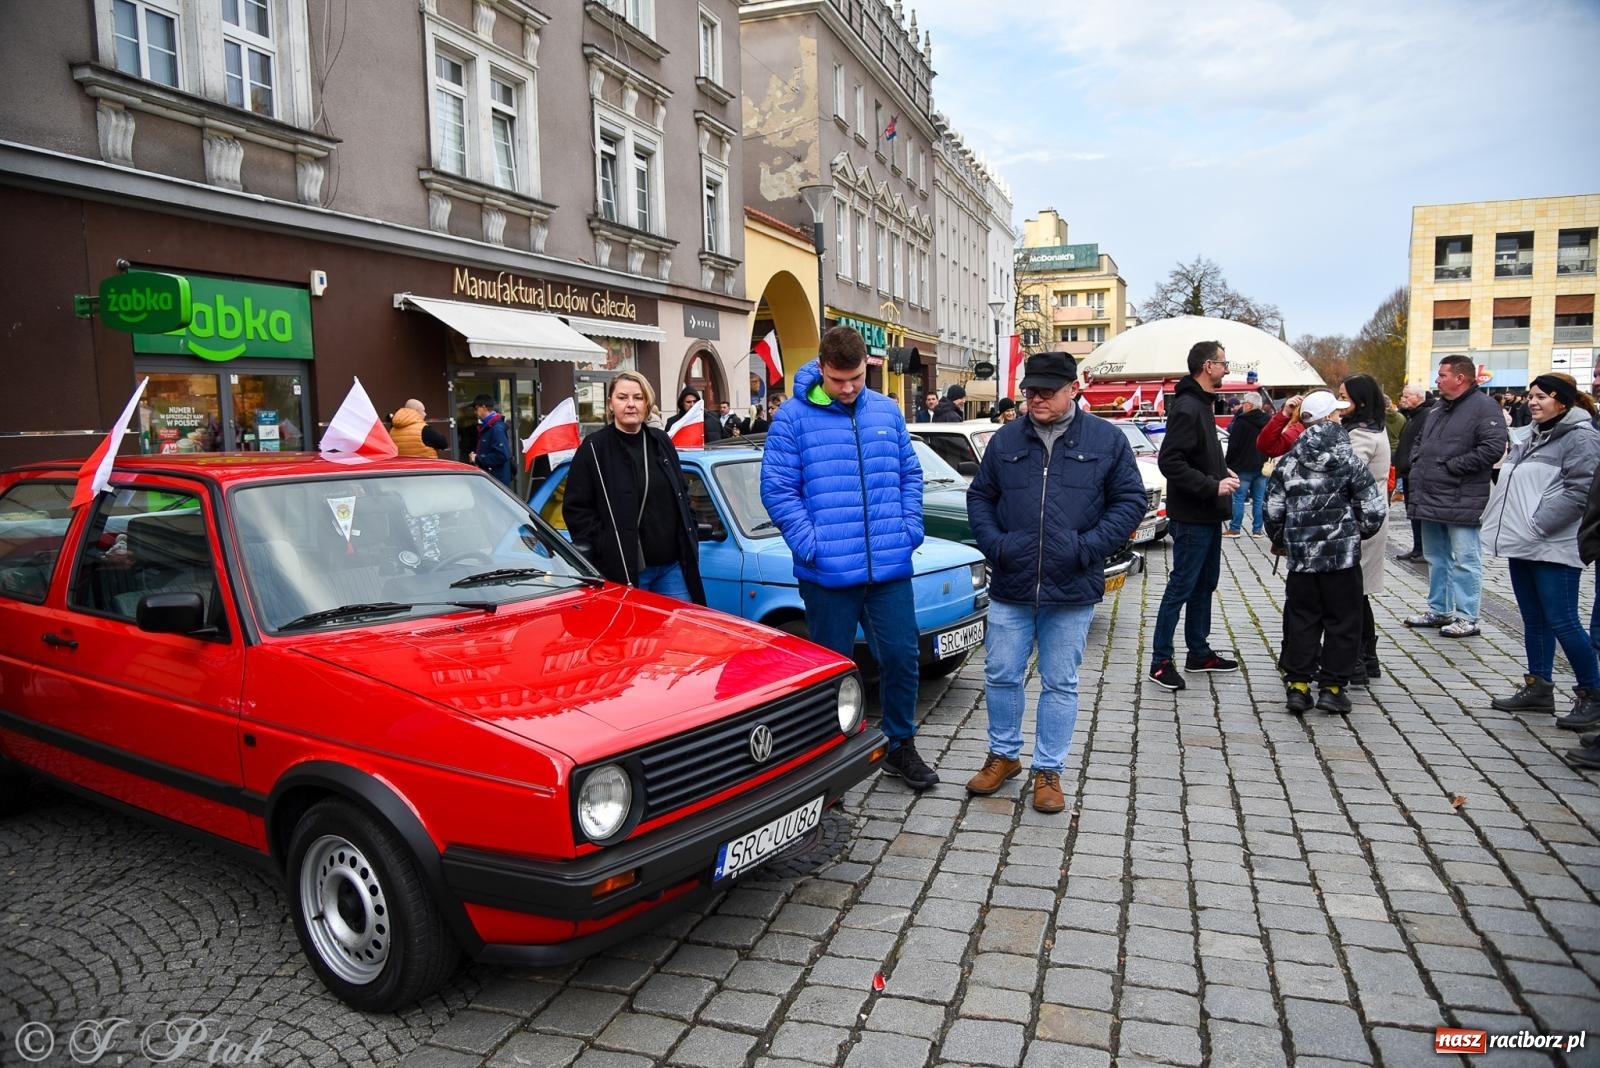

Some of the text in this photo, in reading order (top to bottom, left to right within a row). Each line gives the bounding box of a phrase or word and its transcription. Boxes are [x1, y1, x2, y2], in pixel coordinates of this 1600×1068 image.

[1030, 253, 1075, 263] McDonald's
[107, 288, 173, 312] żabka
[454, 267, 637, 322] Manufaktura Lodów Gałeczka
[163, 294, 293, 342] abka
[169, 406, 192, 414] NUMER
[940, 631, 961, 653] SRC
[729, 827, 769, 869] SRC
[773, 799, 819, 846] UU86
